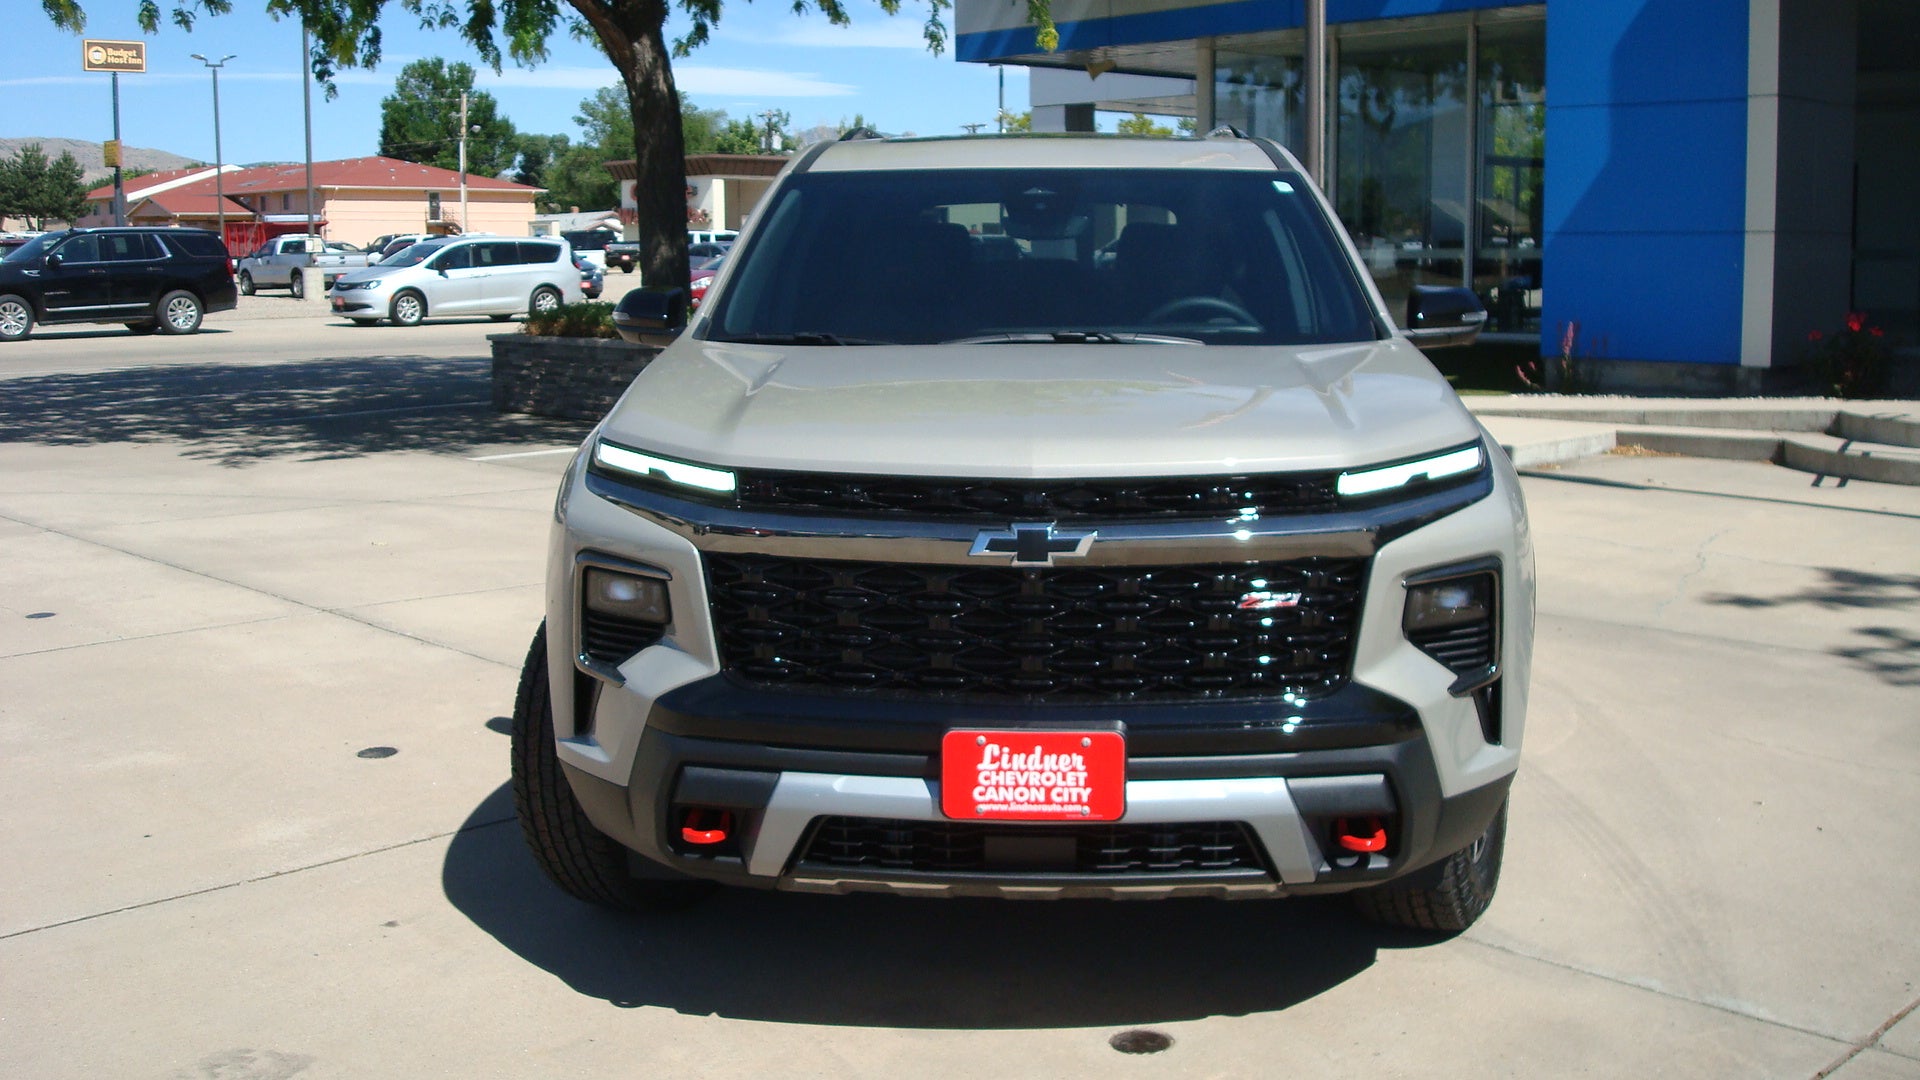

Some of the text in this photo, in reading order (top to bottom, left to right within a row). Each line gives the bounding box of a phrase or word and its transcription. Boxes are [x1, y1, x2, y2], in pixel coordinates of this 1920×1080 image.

[106, 48, 137, 59] Budget
[107, 56, 128, 64] Host
[977, 744, 1086, 771] Lindner
[978, 771, 1088, 786] CHEVROLET
[972, 786, 1092, 803] CANON CITY
